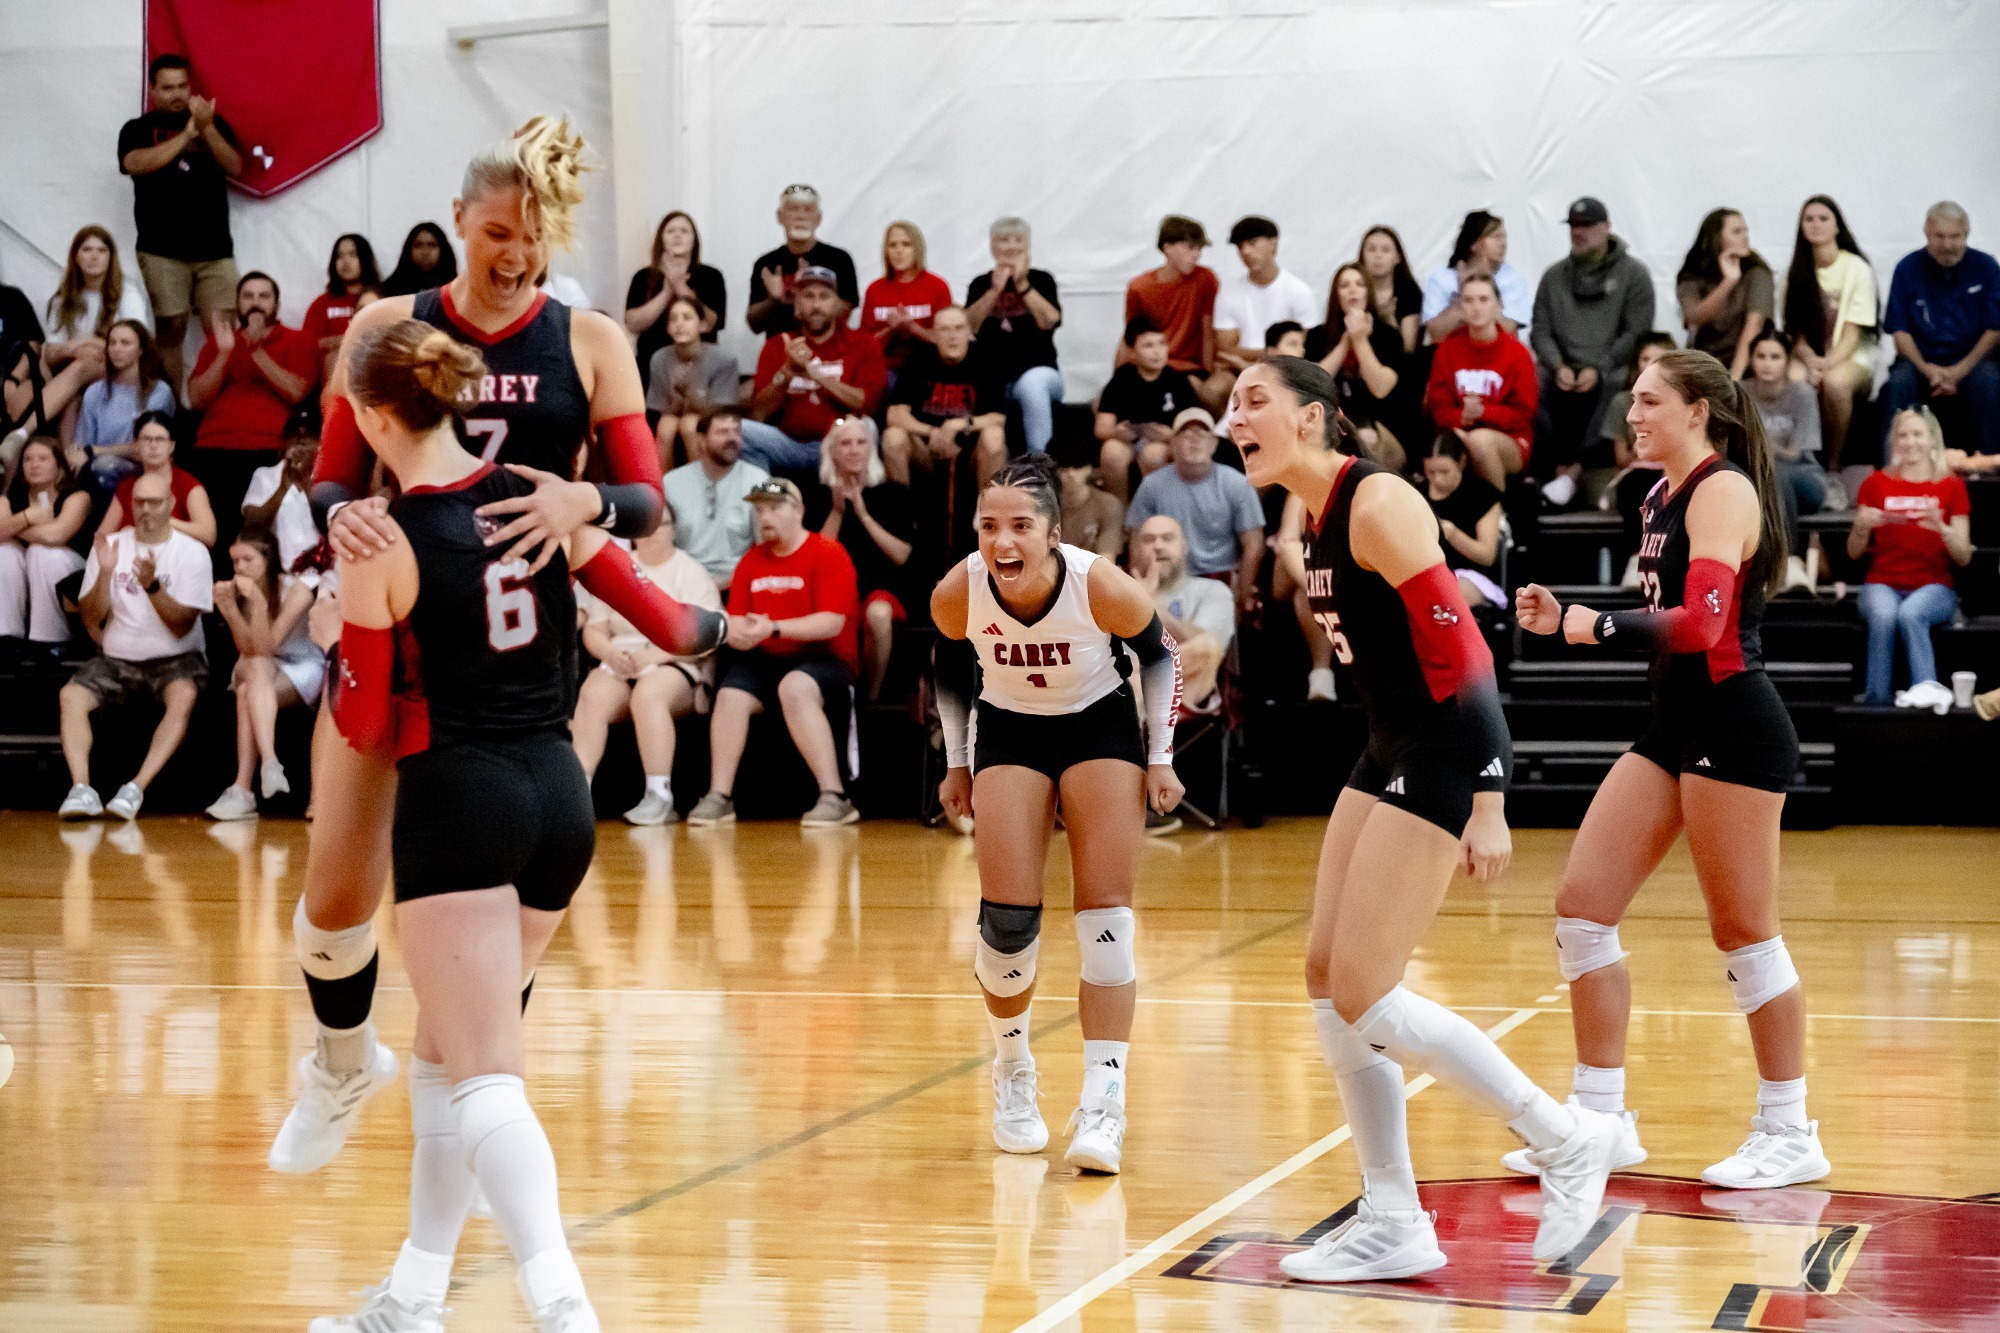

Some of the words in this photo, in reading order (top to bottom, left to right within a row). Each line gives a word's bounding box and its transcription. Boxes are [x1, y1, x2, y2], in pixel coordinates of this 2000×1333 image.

[456, 374, 540, 402] AREY
[465, 418, 509, 463] 7
[1640, 532, 1668, 557] AREY
[484, 557, 538, 651] 6
[993, 642, 1072, 667] CAREY
[1026, 673, 1047, 688] 1
